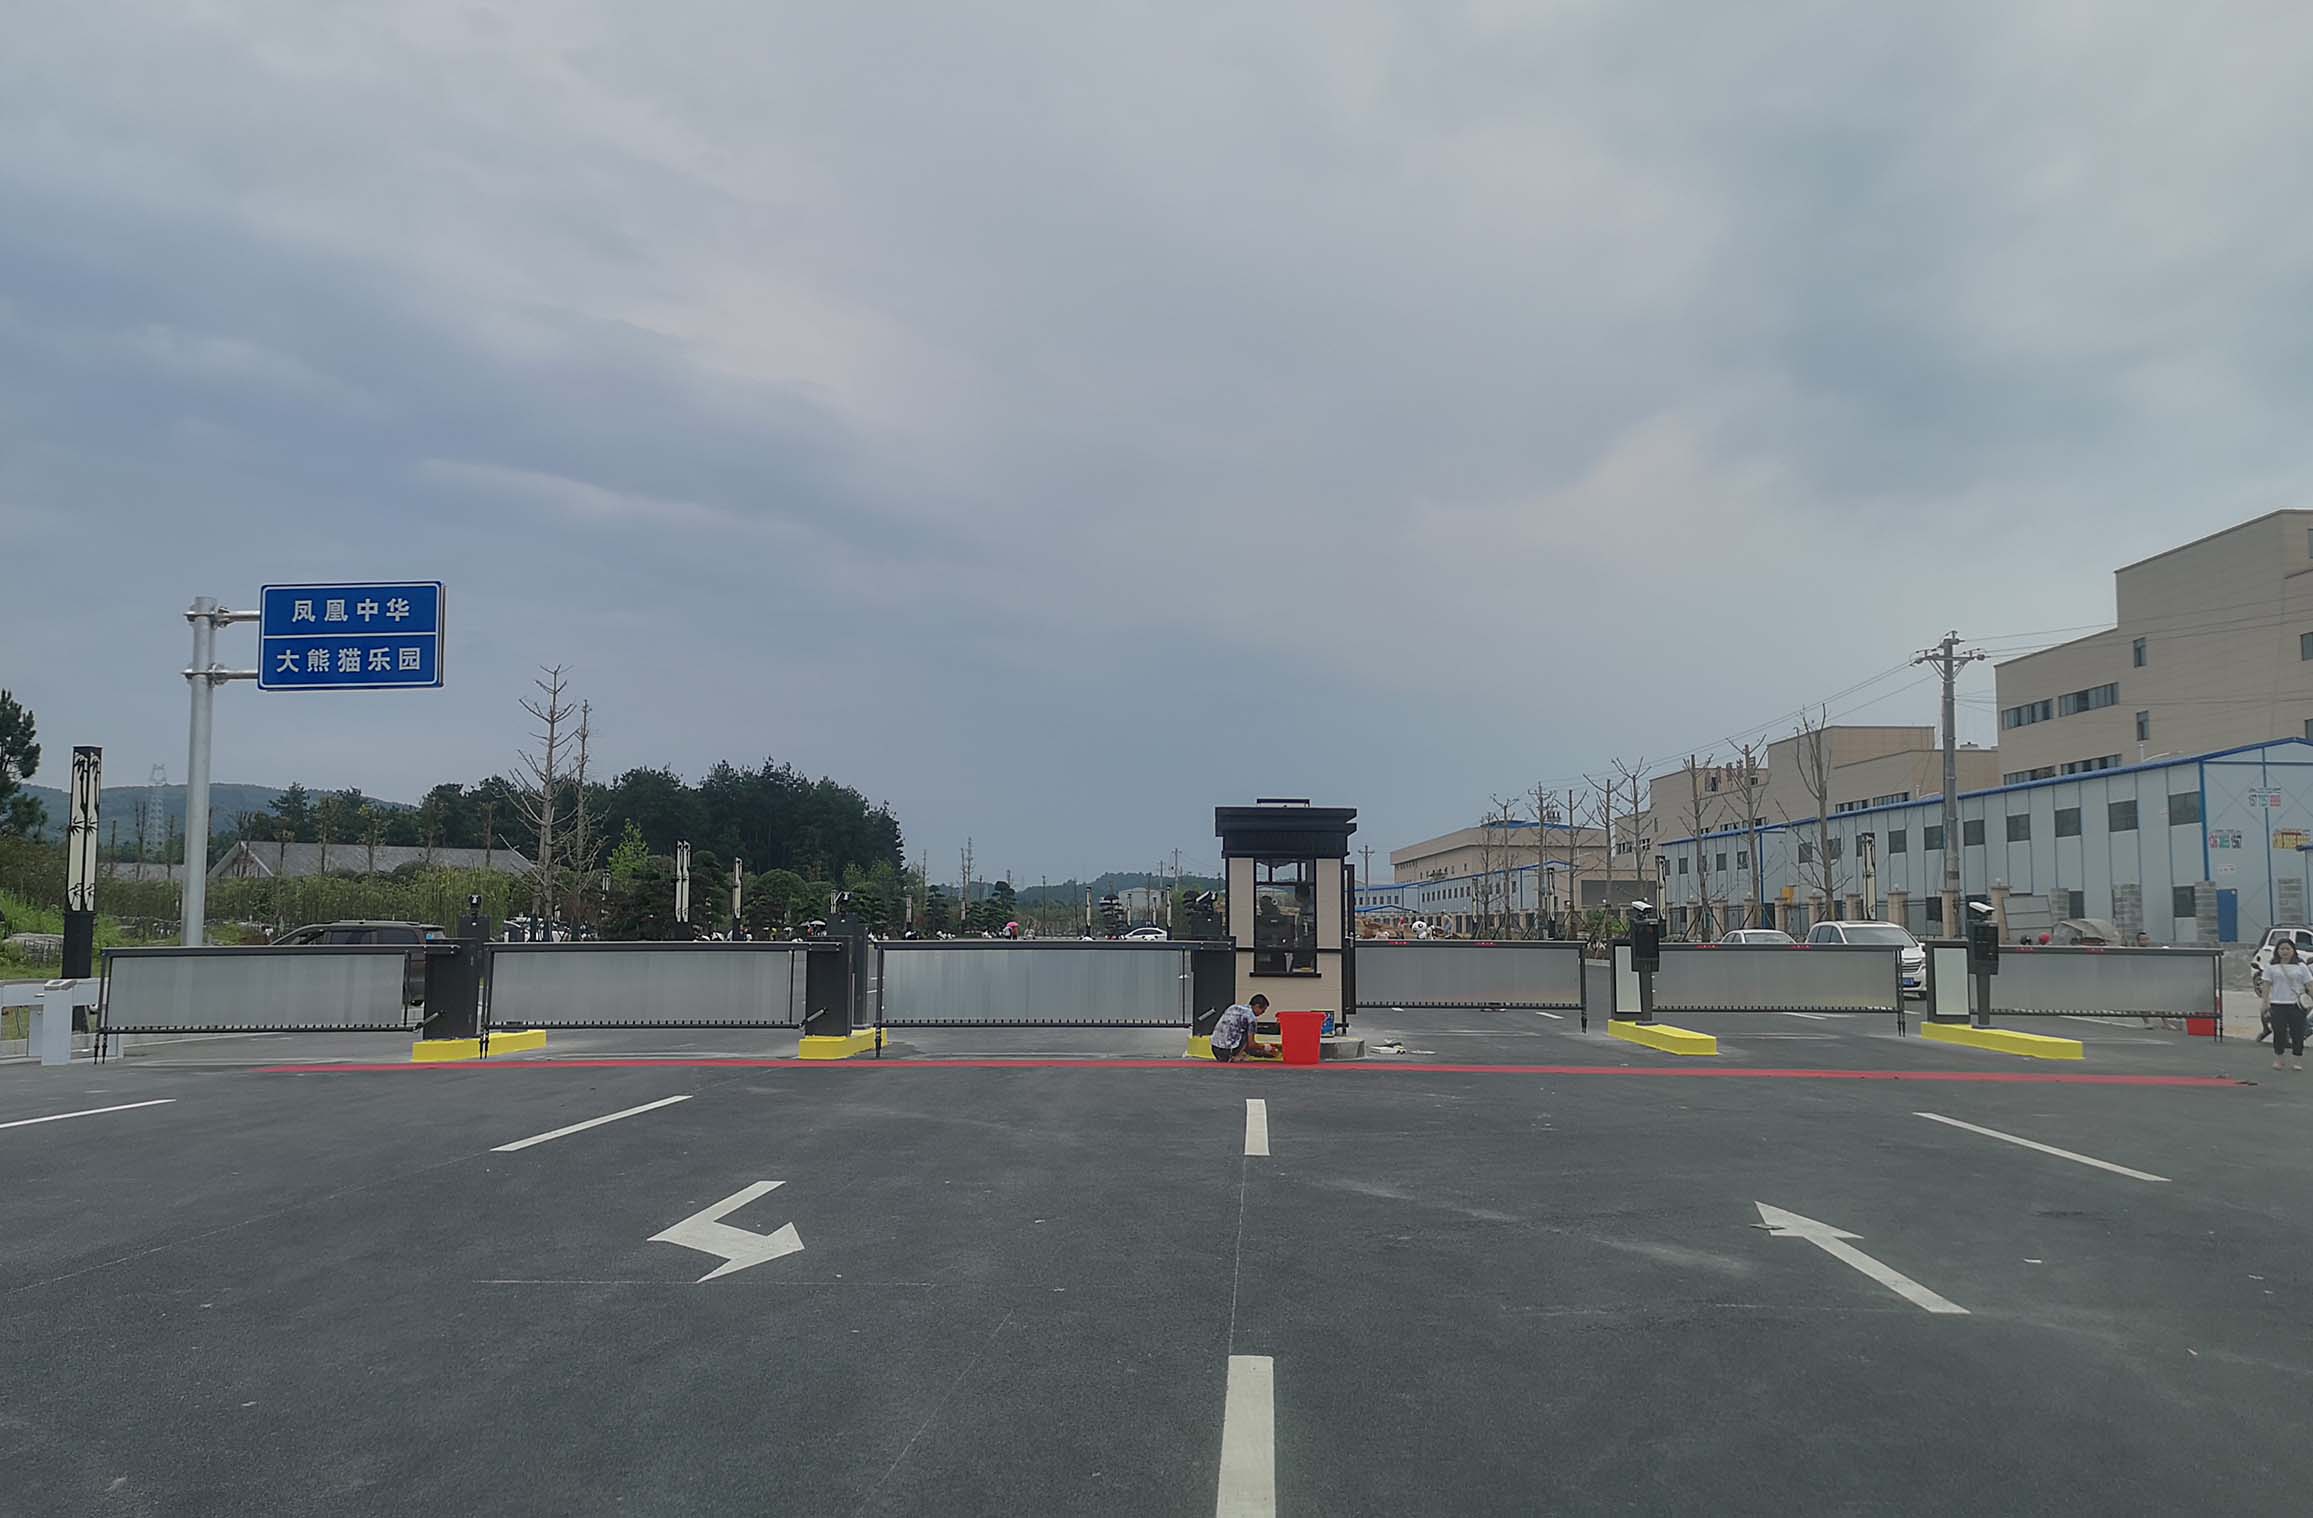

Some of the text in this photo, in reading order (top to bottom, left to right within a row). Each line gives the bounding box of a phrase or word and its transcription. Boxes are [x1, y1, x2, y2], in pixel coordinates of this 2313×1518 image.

[292, 598, 410, 622] 凤凰中华
[276, 647, 420, 672] 大熊猫乐园
